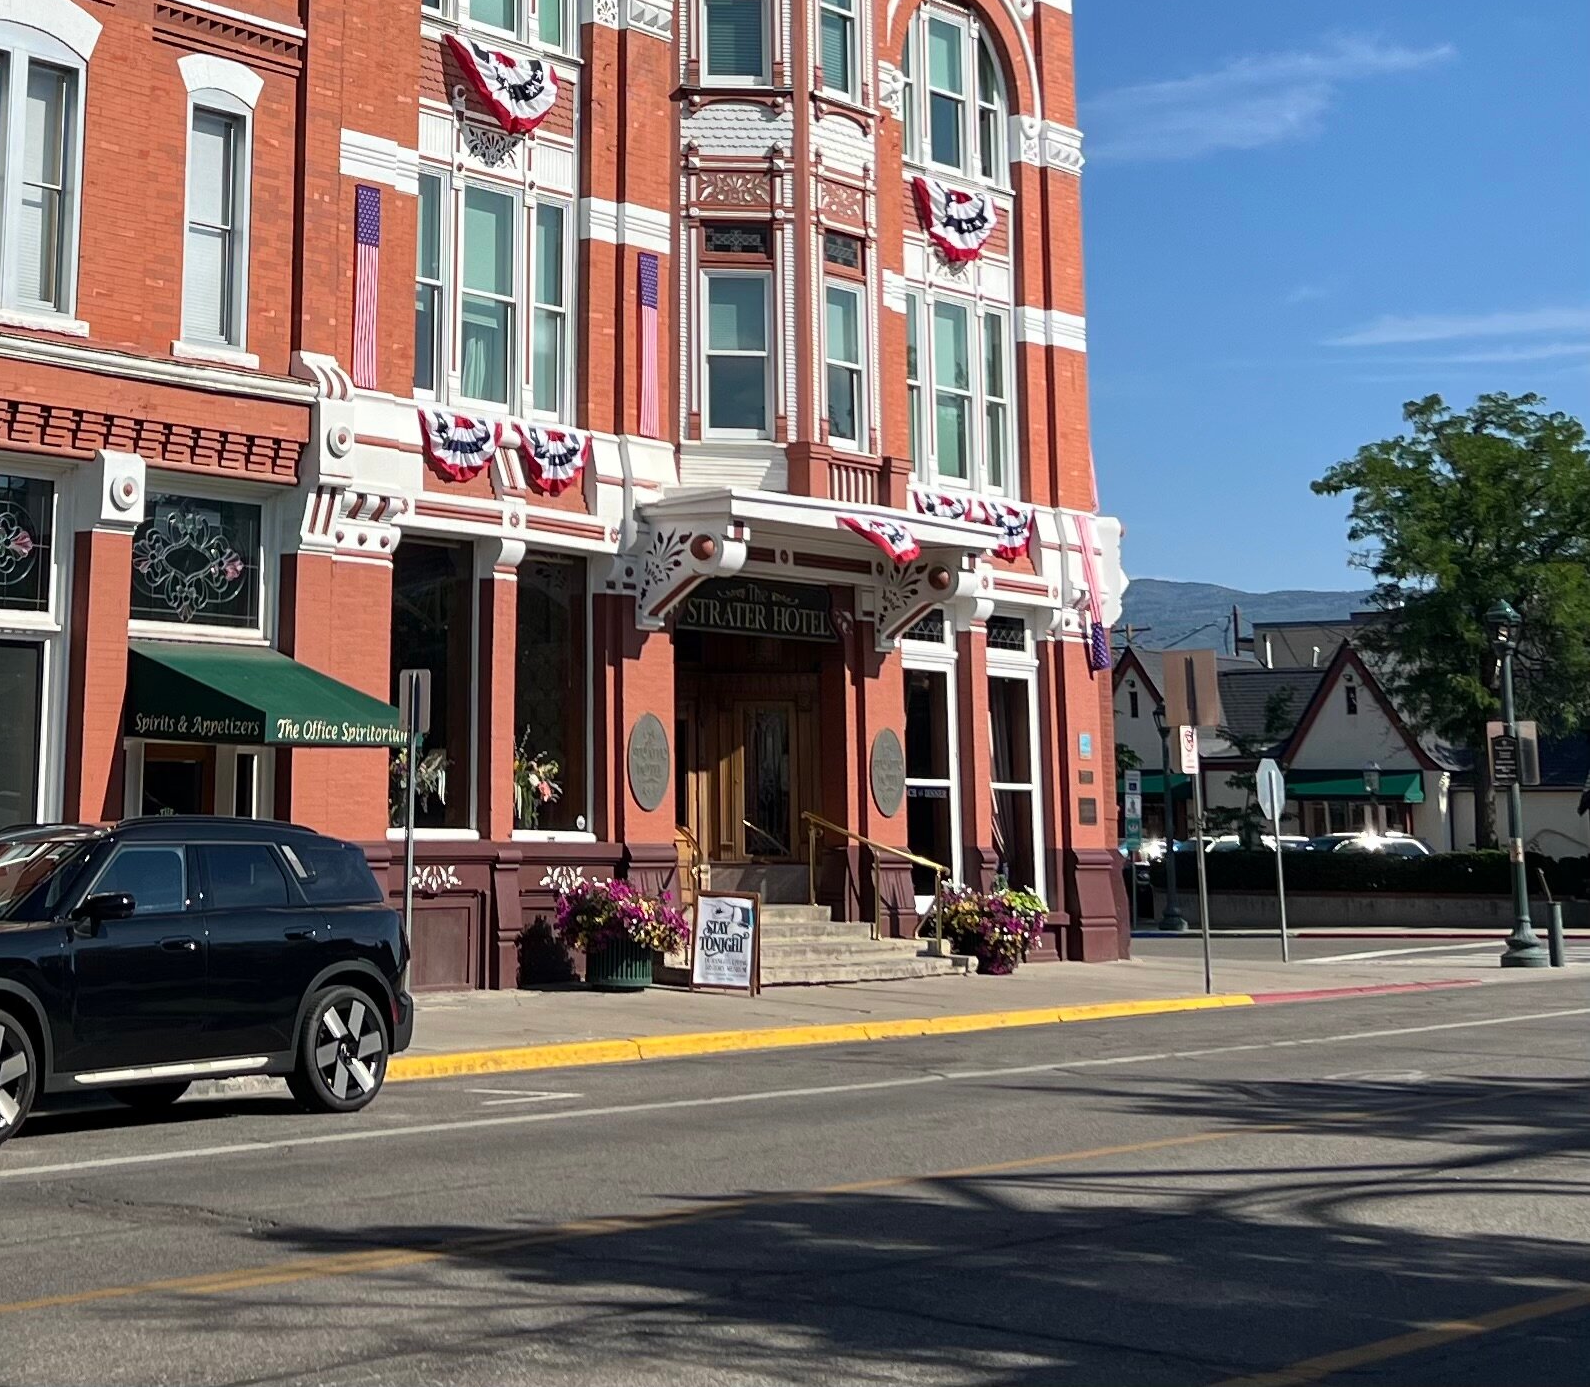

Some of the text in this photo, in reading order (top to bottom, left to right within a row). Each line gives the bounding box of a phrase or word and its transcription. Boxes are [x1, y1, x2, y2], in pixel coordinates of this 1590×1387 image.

[747, 583, 769, 603] The
[687, 598, 831, 636] STRATER HOTEL
[135, 712, 260, 736] Spirits & Appetizers
[277, 718, 300, 740] The
[303, 720, 338, 741] Office
[703, 919, 731, 936] STAY
[699, 932, 750, 957] TONIGHT
